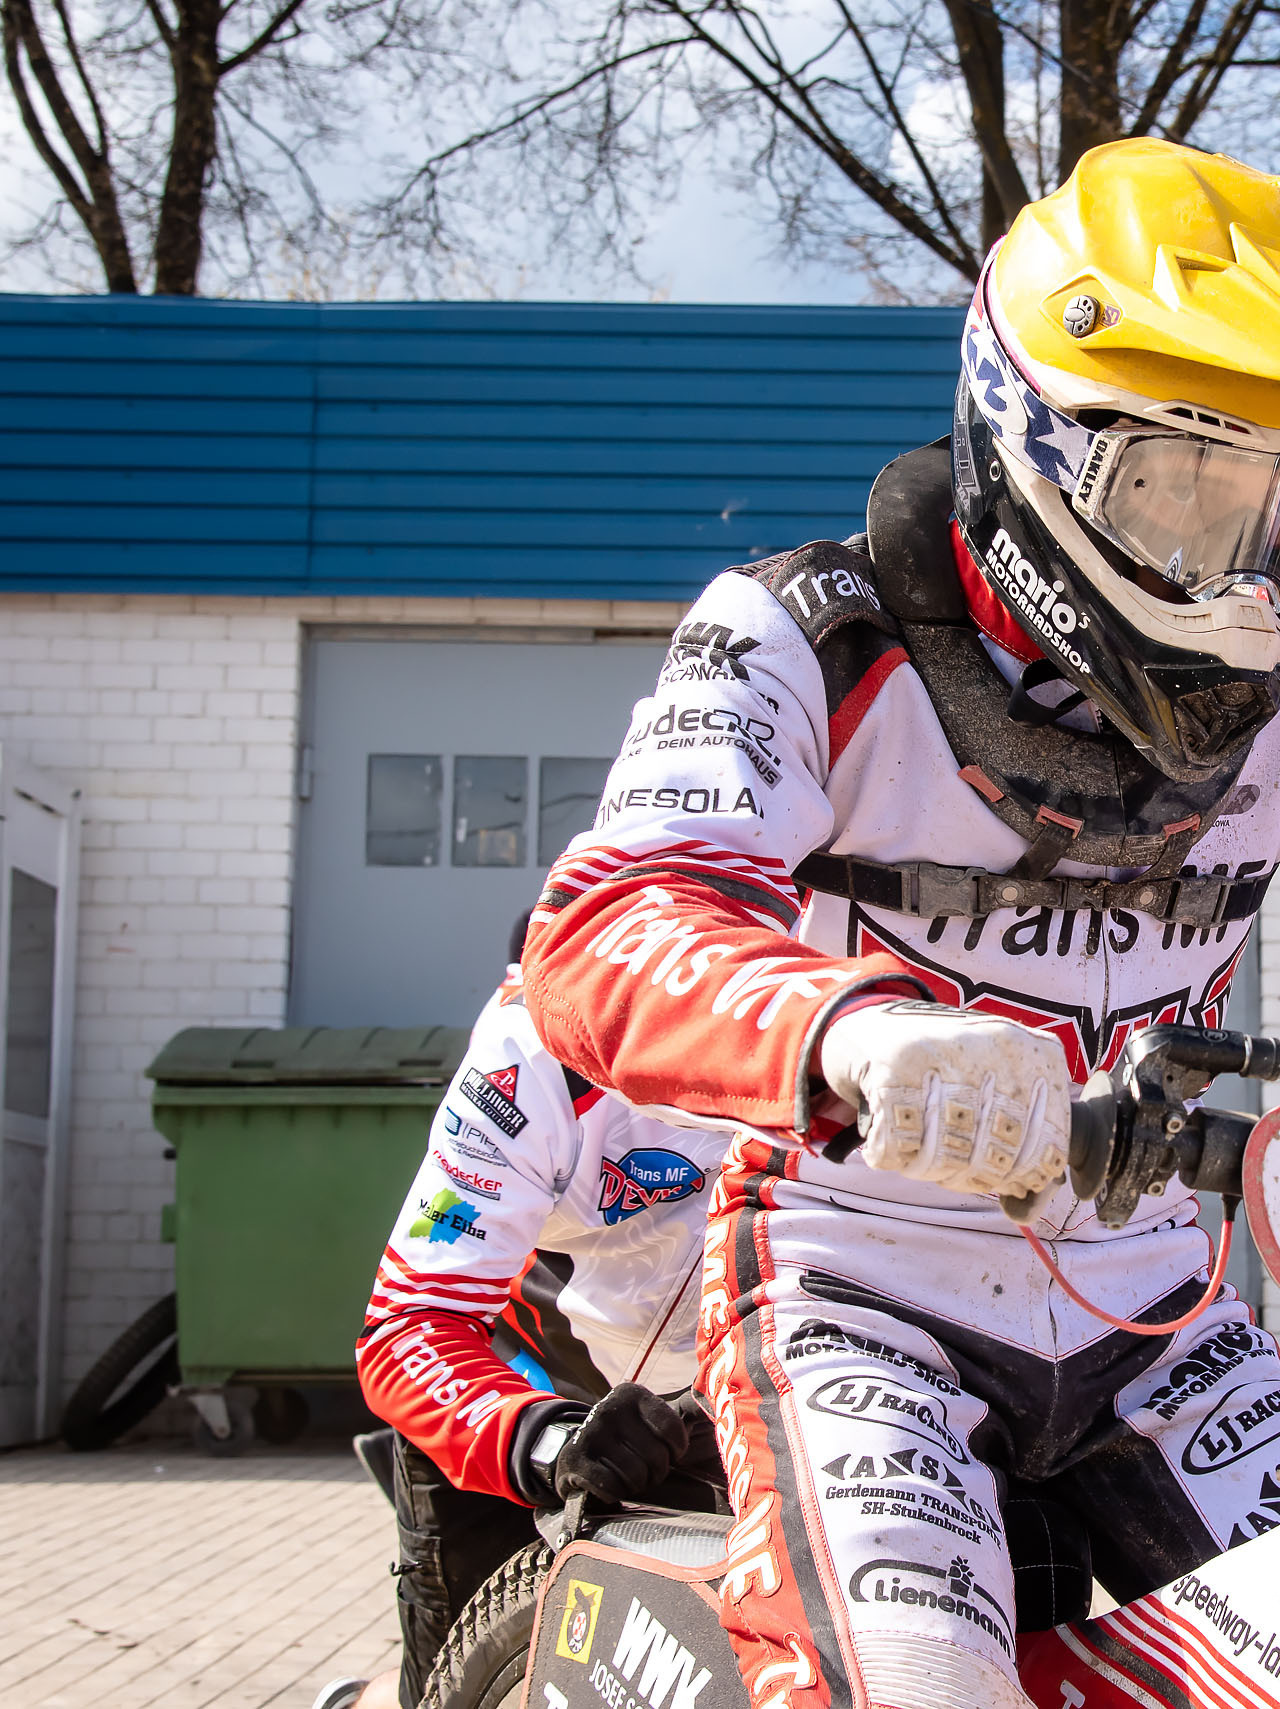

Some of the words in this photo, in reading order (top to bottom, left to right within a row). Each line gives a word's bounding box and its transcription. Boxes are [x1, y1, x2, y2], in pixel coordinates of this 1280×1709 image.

[1078, 438, 1108, 504] OAKLEY
[992, 528, 1091, 634] mario's
[985, 550, 1091, 675] MOTORRADSHOP
[657, 737, 695, 750] DEIN
[629, 1159, 661, 1182] Trans
[665, 1167, 690, 1182] MF
[829, 1384, 882, 1412] LJ
[877, 1392, 958, 1455] RACING
[1198, 1415, 1243, 1462] LJ
[825, 1483, 916, 1503] Gerdemann
[860, 1501, 982, 1545] SH-Stukenbrock
[874, 1577, 1012, 1659] Lienemann
